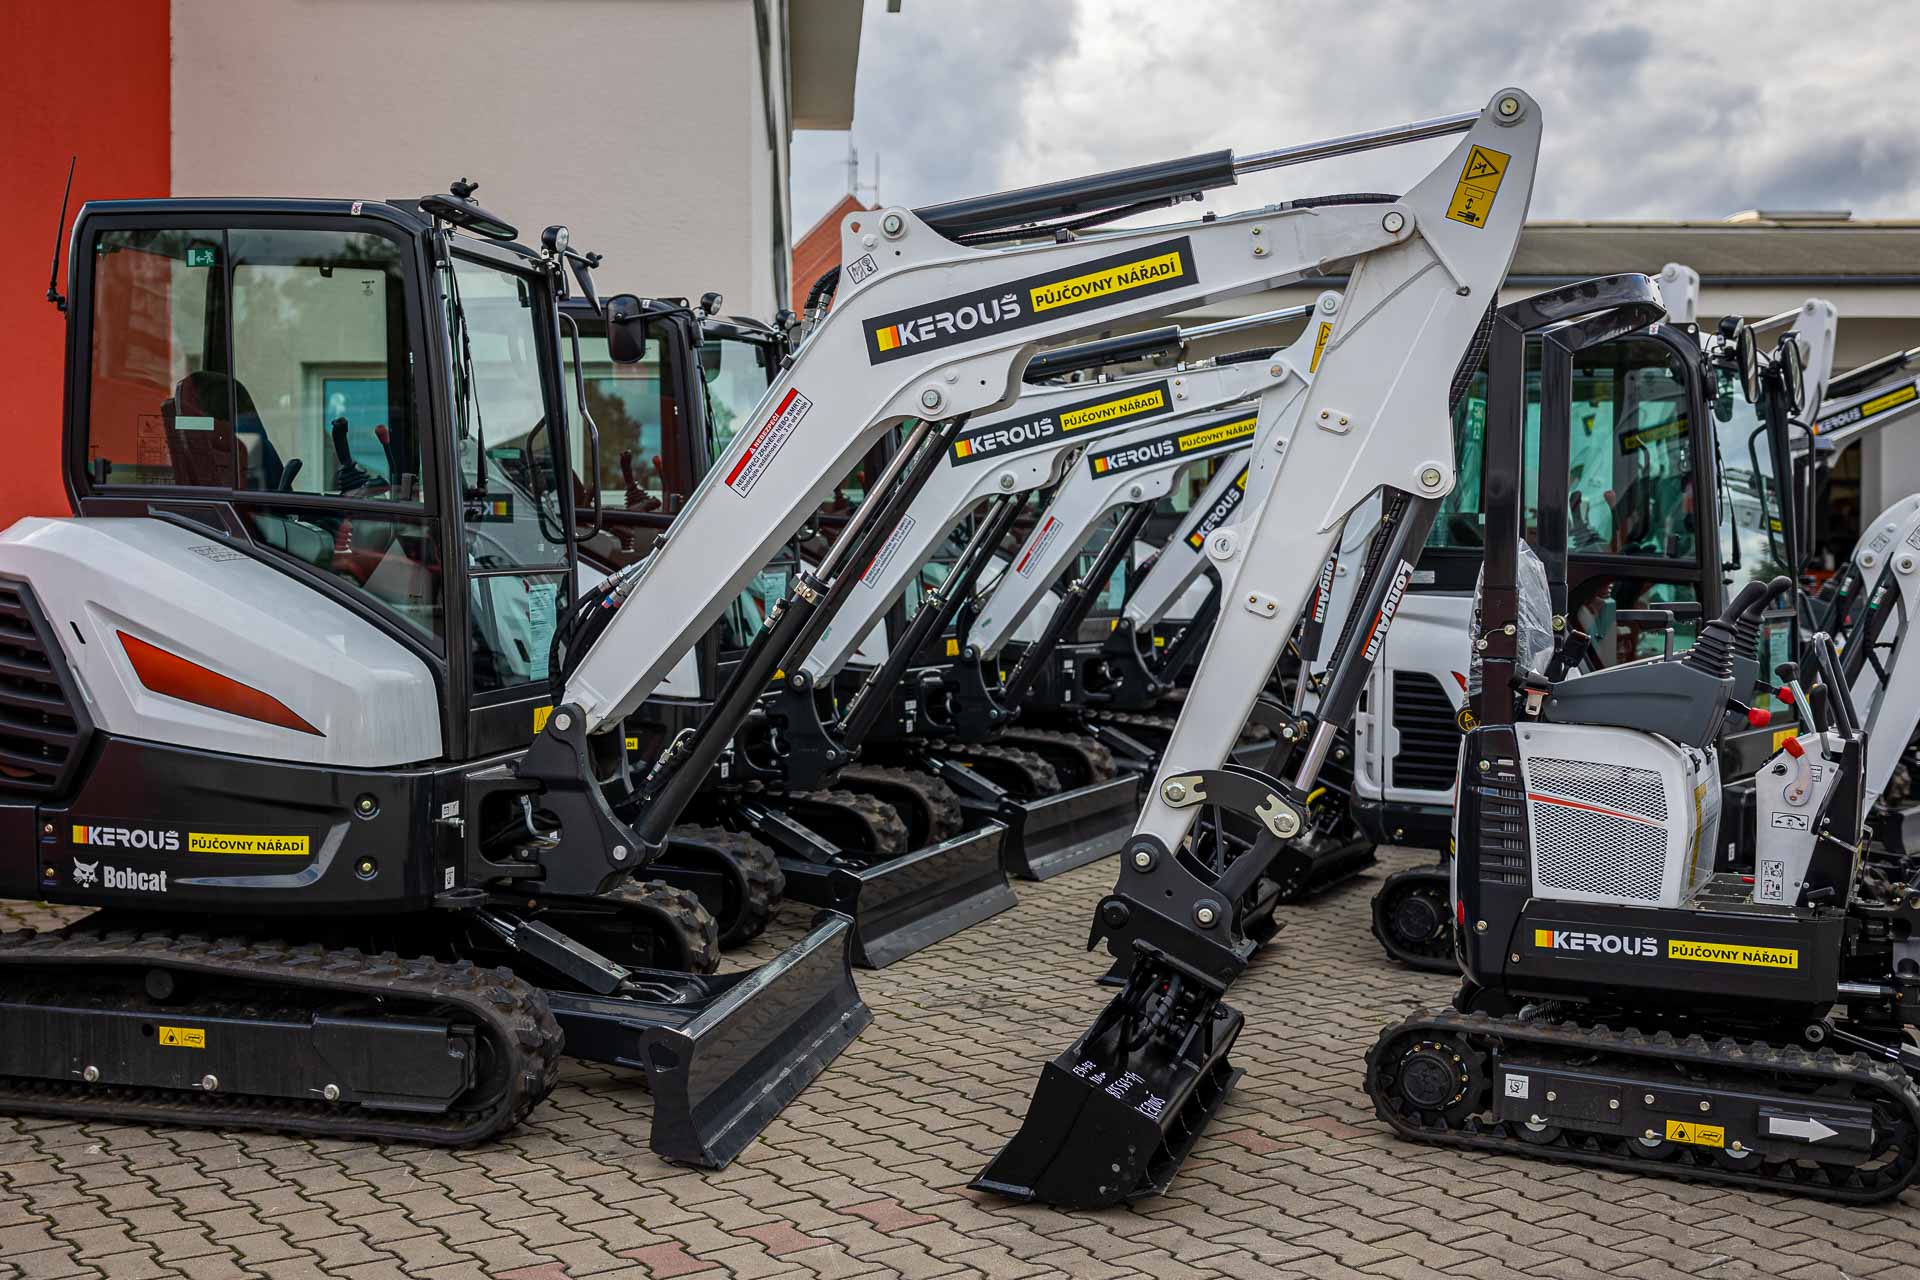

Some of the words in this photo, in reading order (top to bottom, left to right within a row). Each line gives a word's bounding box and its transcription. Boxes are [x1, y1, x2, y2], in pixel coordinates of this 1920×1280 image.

[898, 294, 1021, 346] KEROUŠ
[1035, 277, 1114, 307] PŮJČOVNY
[1117, 257, 1177, 288] NÁŘADÍ
[775, 416, 789, 434] NEBO
[971, 417, 1055, 453] KEROUŠ
[1064, 407, 1117, 428] PŮJČOVNY
[1120, 395, 1159, 414] NÁŘADÍ
[1106, 439, 1174, 471] KEROUŠ
[1181, 431, 1224, 449] PŮJČOVNY
[1364, 559, 1415, 662] LongArm
[89, 826, 180, 850] KEROUŠ
[191, 836, 253, 851] PŮJČOVNY
[257, 837, 304, 851] NÁŘADÍ
[104, 866, 167, 892] Bobcat
[1553, 931, 1658, 957] KEROUŠ
[1671, 944, 1740, 960] PŮJČOVNY
[1742, 948, 1793, 965] NÁŘADÍ
